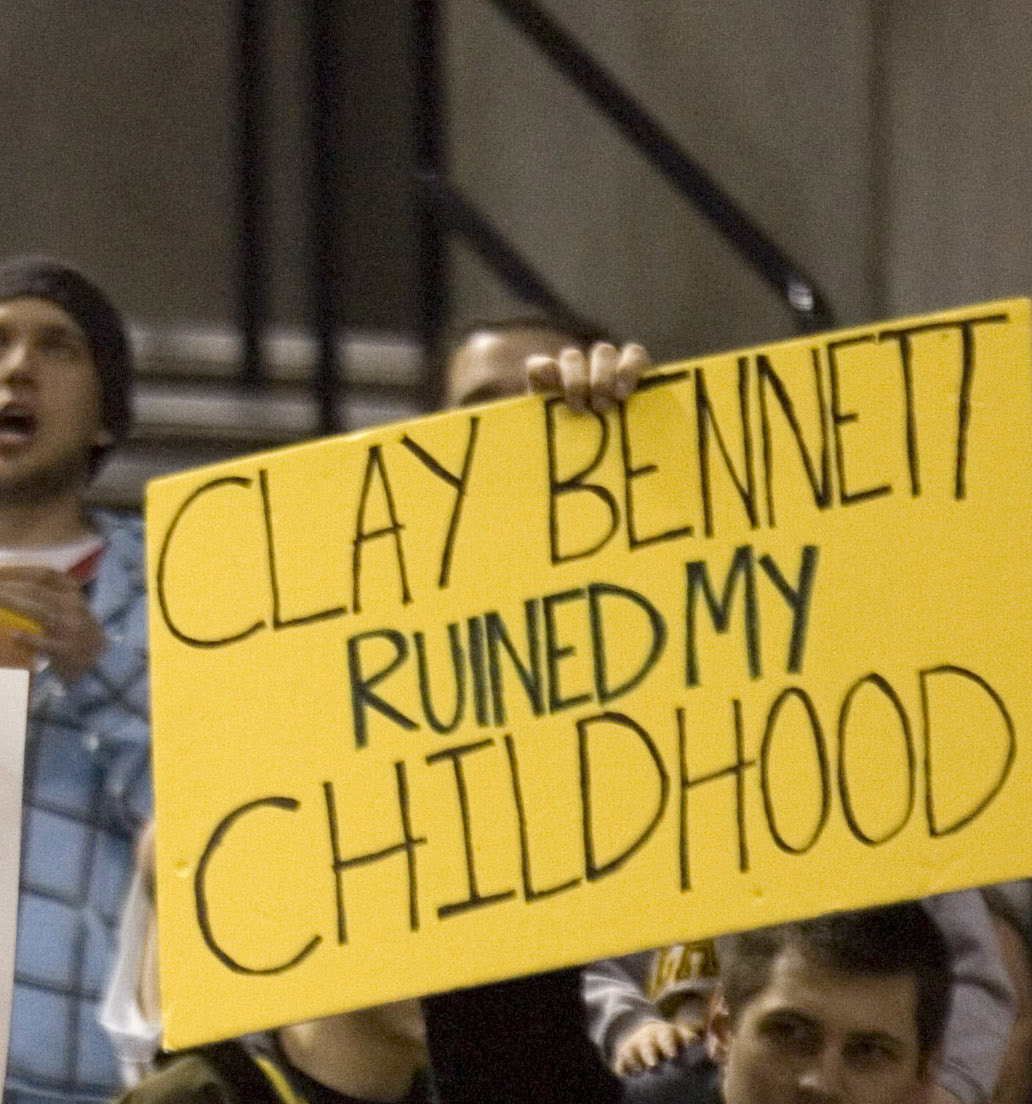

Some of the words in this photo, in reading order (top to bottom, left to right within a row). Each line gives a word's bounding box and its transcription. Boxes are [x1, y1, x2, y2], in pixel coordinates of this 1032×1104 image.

[157, 417, 481, 648] CLAY
[543, 314, 1009, 566] BENNETT
[347, 582, 667, 748] RUINED
[684, 545, 818, 688] MY
[194, 664, 1016, 975] CHILDHOOD
